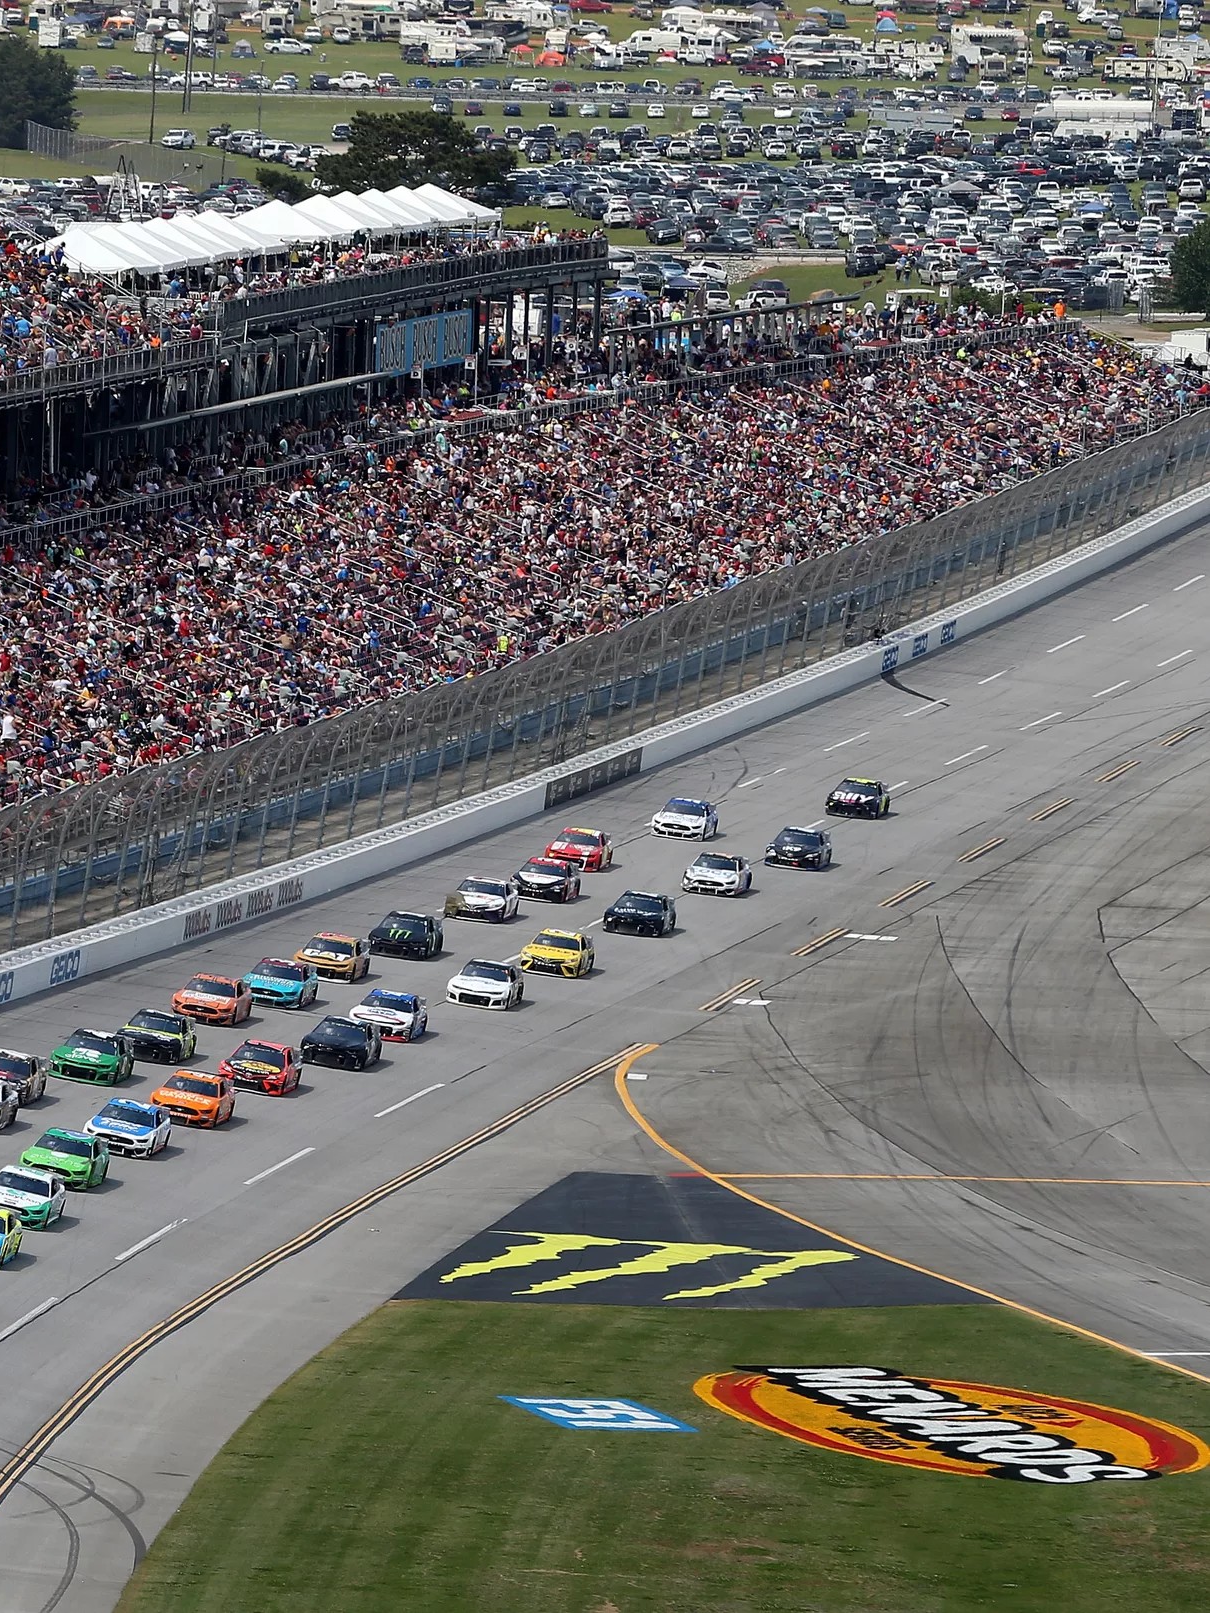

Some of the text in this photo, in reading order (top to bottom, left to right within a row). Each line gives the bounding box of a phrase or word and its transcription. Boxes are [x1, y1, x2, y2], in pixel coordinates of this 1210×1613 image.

[380, 323, 406, 371] BUSCH
[412, 317, 438, 365] BUSCH
[443, 313, 469, 362] BUSCH
[833, 791, 874, 803] ally
[50, 950, 81, 985] GEICO
[303, 948, 351, 962] CAT
[516, 1398, 681, 1430] FS1
[764, 1367, 1152, 1485] MENARDS
